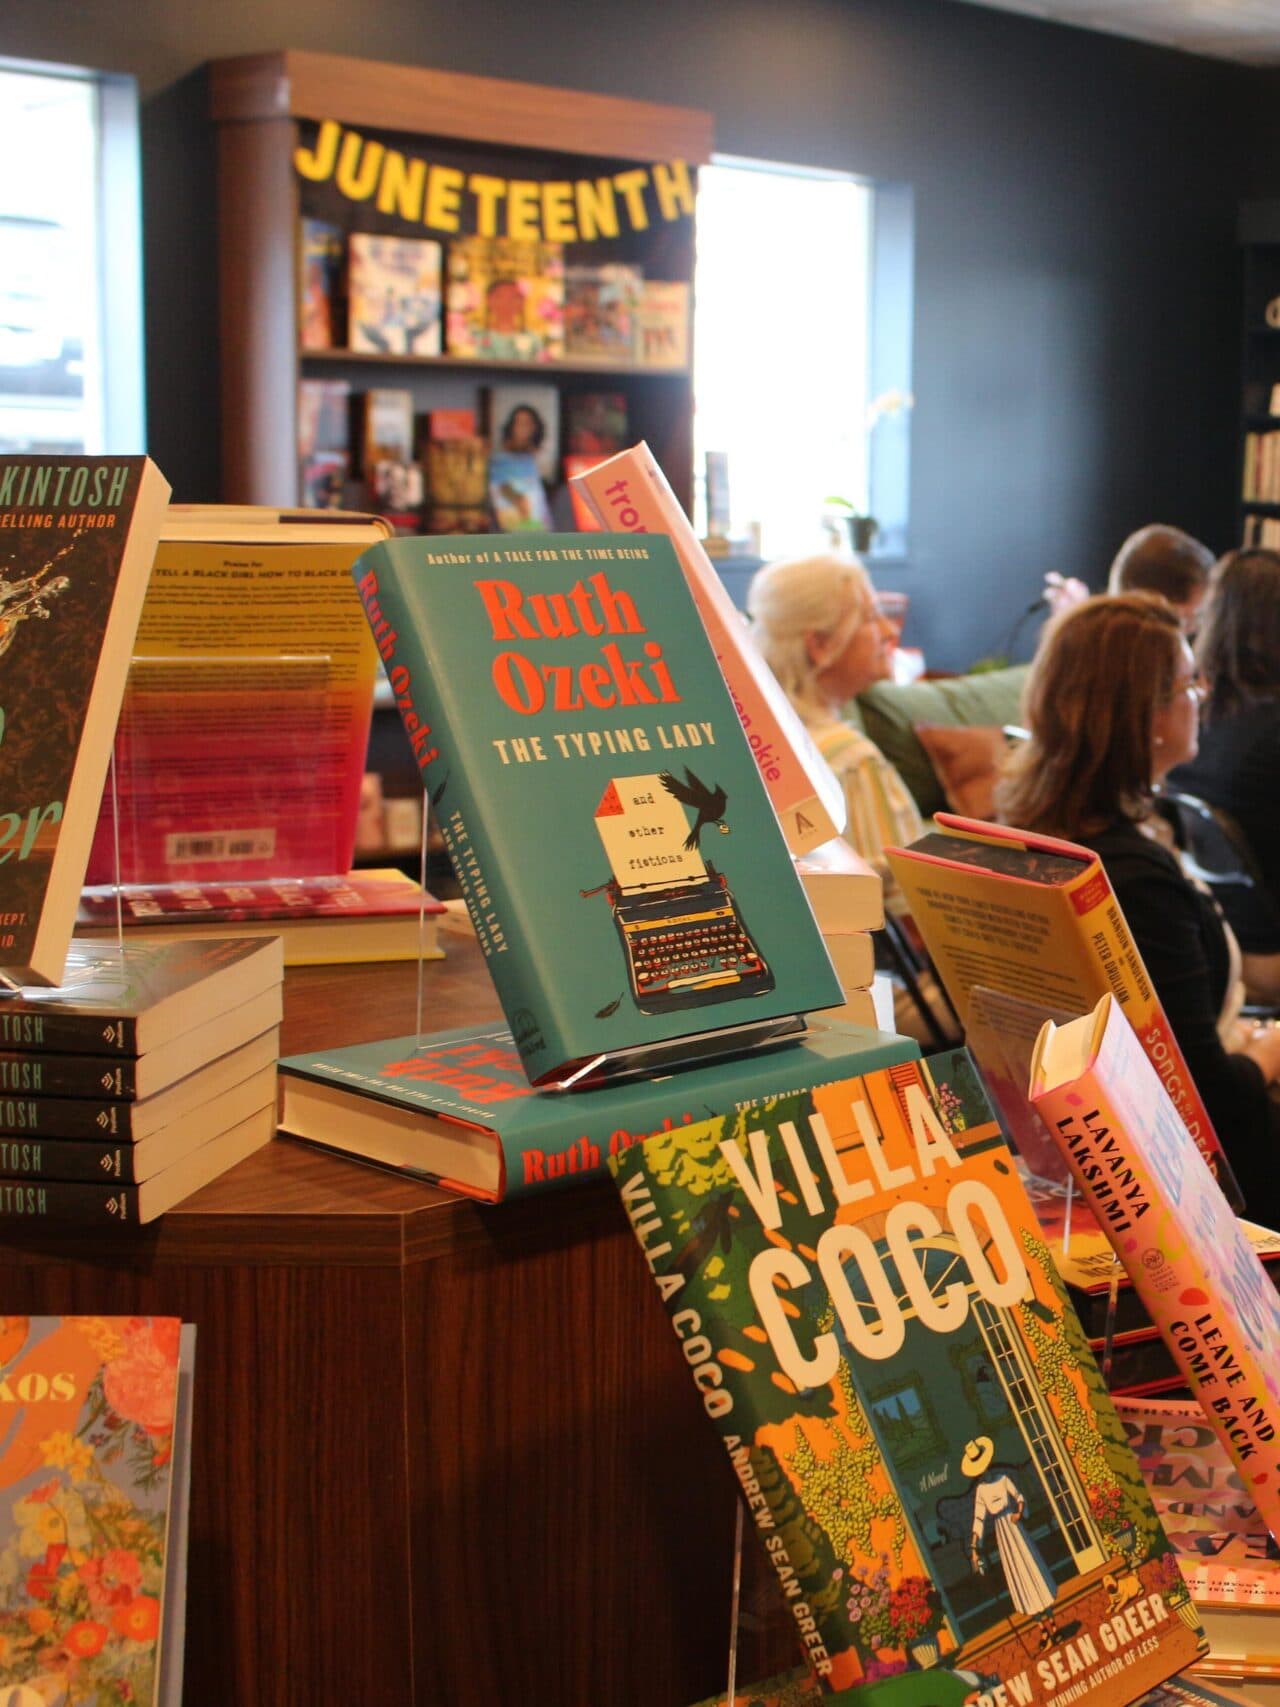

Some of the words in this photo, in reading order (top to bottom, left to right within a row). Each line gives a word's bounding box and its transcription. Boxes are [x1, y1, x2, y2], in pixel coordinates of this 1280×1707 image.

[293, 118, 697, 244] JUNETEENTH
[57, 514, 116, 528] AUTHOR
[605, 480, 649, 533] tro
[156, 569, 178, 577] TELL
[192, 569, 227, 578] BLACK
[231, 570, 254, 578] GIRL
[258, 570, 284, 578] HOW
[287, 569, 301, 577] TO
[304, 569, 337, 577] BLACK
[427, 552, 472, 565] Author
[476, 551, 489, 563] of
[493, 551, 502, 562] A
[504, 550, 534, 562] TALE
[536, 550, 558, 561] FOR
[561, 549, 583, 560] THE
[586, 548, 615, 560] TIME
[617, 548, 650, 560] BEING
[473, 571, 648, 641] Ruth
[357, 569, 399, 664] Ruth
[389, 664, 440, 769] Ozeki
[491, 641, 684, 716] Ozeki
[492, 736, 548, 765] THE
[554, 727, 651, 758] TYPING
[656, 722, 716, 755] LADY
[628, 826, 665, 839] other
[633, 793, 655, 806] and
[450, 810, 469, 844] THE
[463, 847, 492, 909] TYPING
[485, 912, 509, 953] LADY
[628, 855, 684, 870] fictions
[451, 855, 470, 895] OTHER
[467, 898, 493, 957] FICTIONS
[1092, 931, 1114, 961] PETER
[1146, 1027, 1187, 1105] SONGS
[521, 1136, 601, 1184] Ruth
[720, 1083, 963, 1231] VILLA
[1056, 1116, 1131, 1233] LAKSHMI
[1082, 1109, 1151, 1219] LAVANYA
[0, 1187, 47, 1214] TOSH
[748, 1180, 1029, 1392] COCO
[1168, 1321, 1218, 1389] COME
[1211, 1396, 1258, 1461] BACK
[1193, 1313, 1247, 1389] LEAVE
[1239, 1396, 1276, 1443] AND
[620, 1171, 686, 1304] VILLA
[672, 1308, 734, 1419] COCO
[723, 1434, 775, 1529] ANDREW
[765, 1535, 802, 1599] SEAN
[791, 1602, 833, 1677] GREER
[1037, 1632, 1100, 1691] SEAN
[1099, 1593, 1169, 1653] GREER
[1088, 1657, 1125, 1688] AUTHOR
[1124, 1650, 1136, 1665] OF
[1137, 1636, 1160, 1658] LESS
